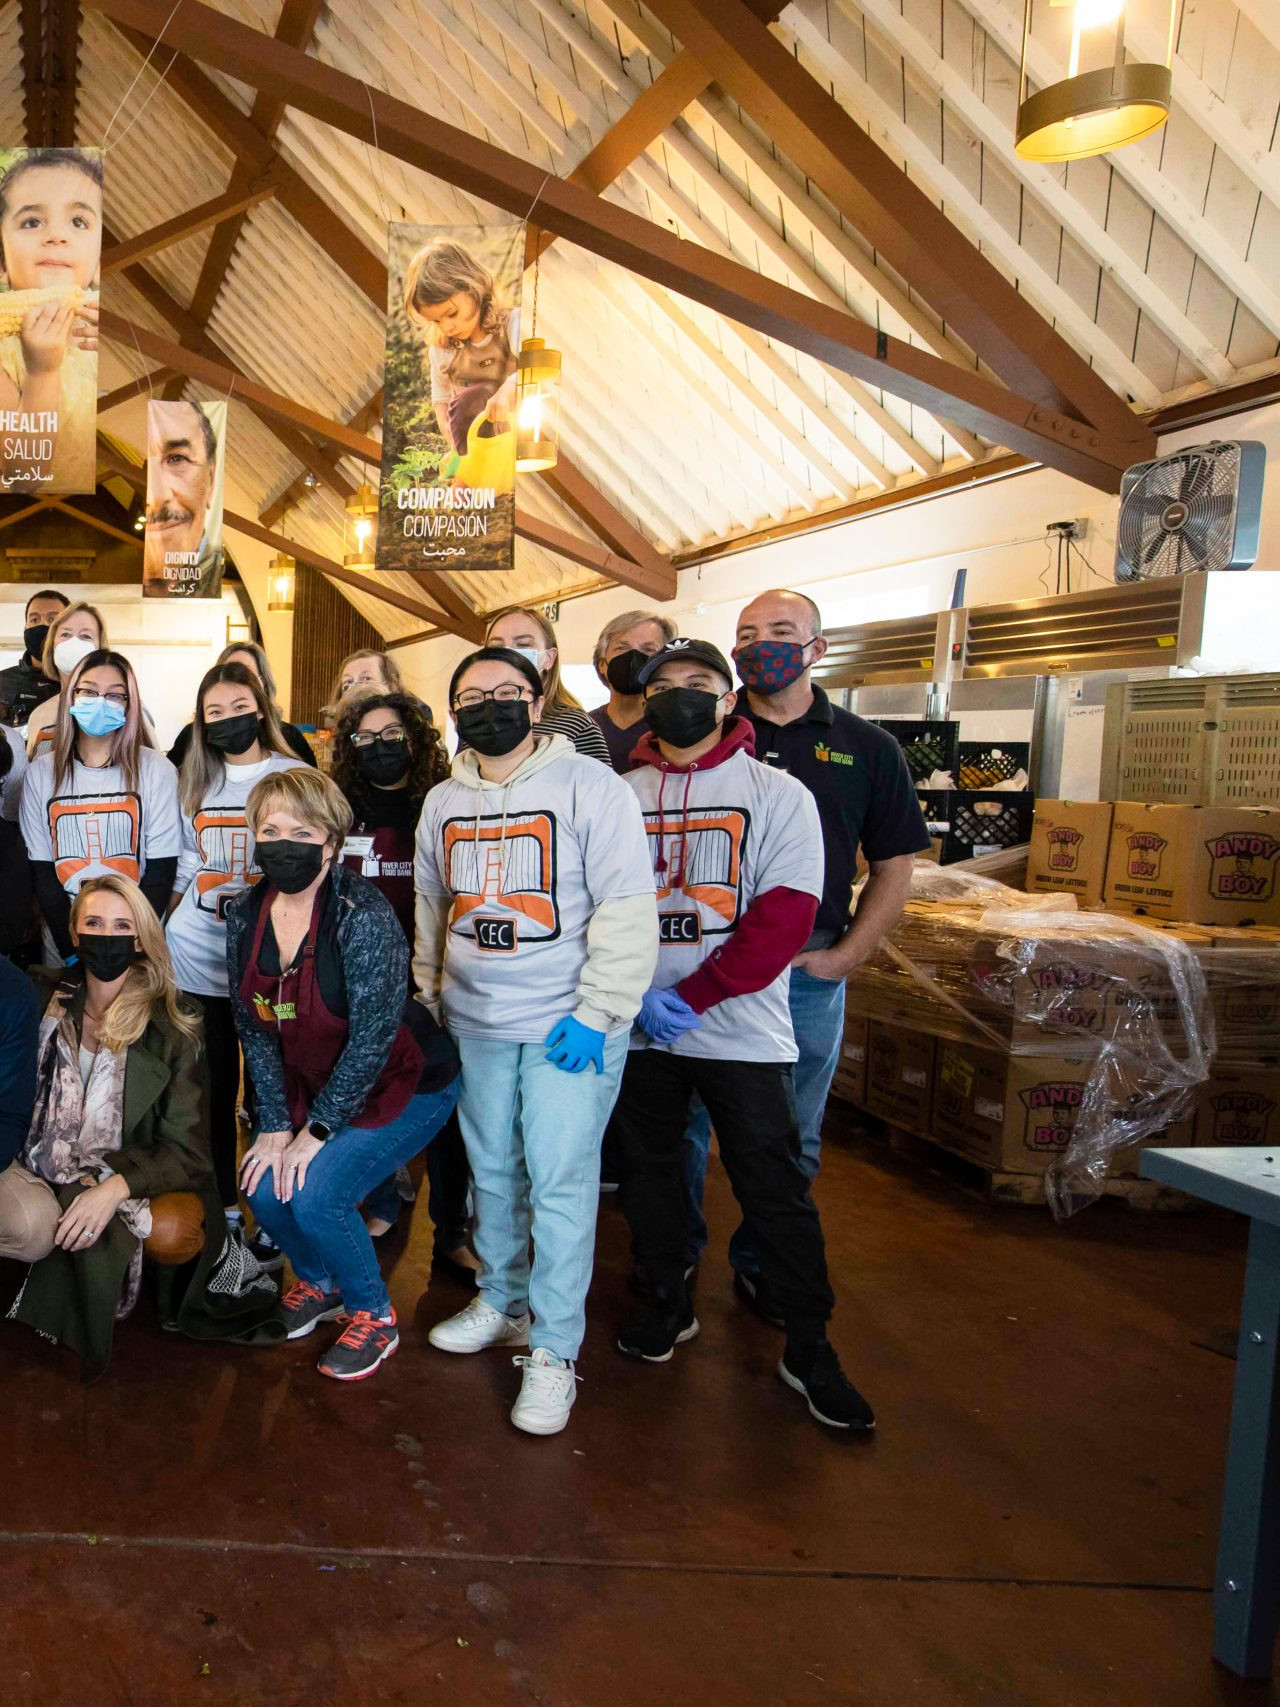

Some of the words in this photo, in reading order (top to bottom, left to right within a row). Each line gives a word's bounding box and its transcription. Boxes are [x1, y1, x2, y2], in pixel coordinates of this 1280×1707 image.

[0, 410, 58, 433] HEALTH
[3, 437, 53, 460] SALUD
[397, 487, 495, 510] COMPASSION
[403, 511, 487, 537] COMPASIÓN
[164, 551, 200, 565] DIGNITY
[422, 543, 466, 561] محبت
[163, 567, 202, 581] DIGNIDAD
[1050, 830, 1081, 846] ANDY
[1129, 835, 1164, 852] ANDY
[1215, 836, 1277, 861] ANDY
[381, 861, 398, 869] RIVER
[399, 861, 412, 869] CITY
[1052, 854, 1075, 868] BOY
[1131, 861, 1157, 876] BOY
[381, 869, 396, 877] FOOD
[397, 869, 413, 877] BANK
[1219, 874, 1267, 895] BOY
[479, 922, 509, 946] CEC
[660, 917, 693, 939] CEC
[1029, 1088, 1083, 1109] AND
[1034, 1126, 1071, 1146] BO
